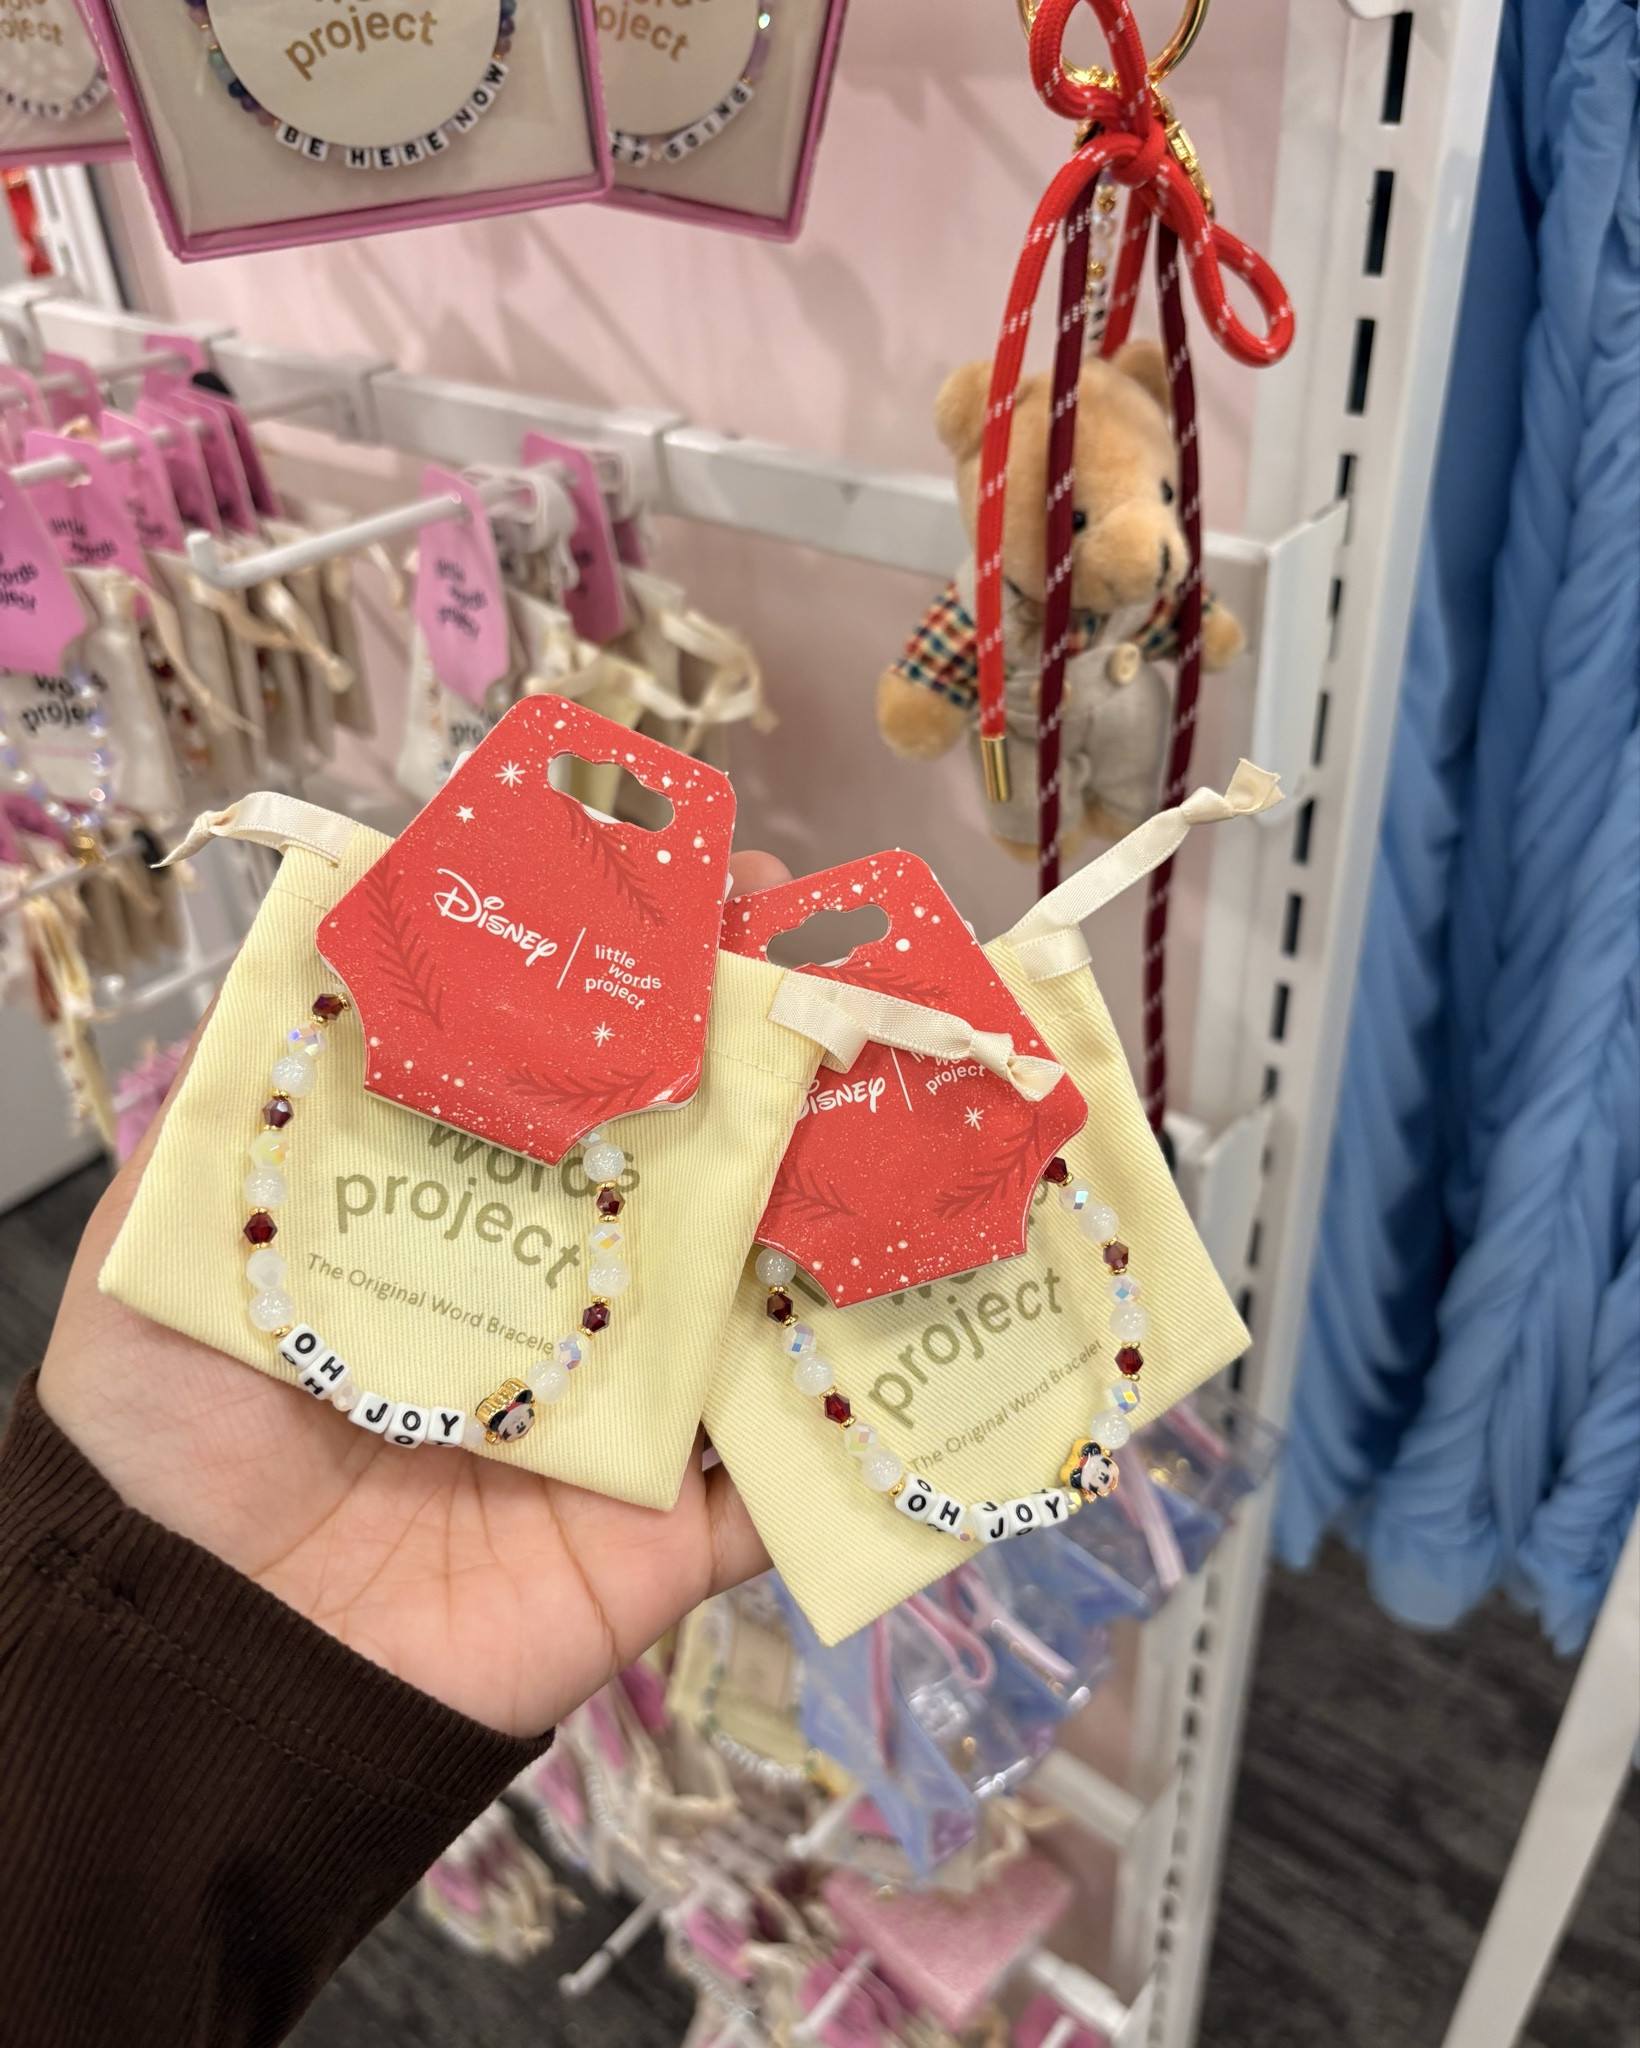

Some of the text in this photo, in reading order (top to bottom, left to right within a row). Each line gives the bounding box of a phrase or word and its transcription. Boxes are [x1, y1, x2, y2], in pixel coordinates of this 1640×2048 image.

[285, 5, 437, 81] project
[598, 5, 689, 62] oject
[283, 63, 506, 167] BE HERE NOW
[665, 86, 749, 160] GOING
[22, 698, 92, 733] proje
[434, 867, 558, 967] Disney
[585, 977, 645, 1011] project
[594, 944, 636, 970] little
[608, 962, 662, 990] words
[800, 1076, 886, 1121] isney
[925, 1063, 987, 1096] project
[336, 1172, 581, 1291] project
[308, 1252, 555, 1356] The Original Word Bracele
[294, 1332, 460, 1437] OH JOY
[868, 1267, 1063, 1430] project
[908, 1450, 943, 1473] The
[945, 1405, 1008, 1453] Original
[1011, 1377, 1049, 1414] Word
[907, 1494, 1061, 1540] OH JOY
